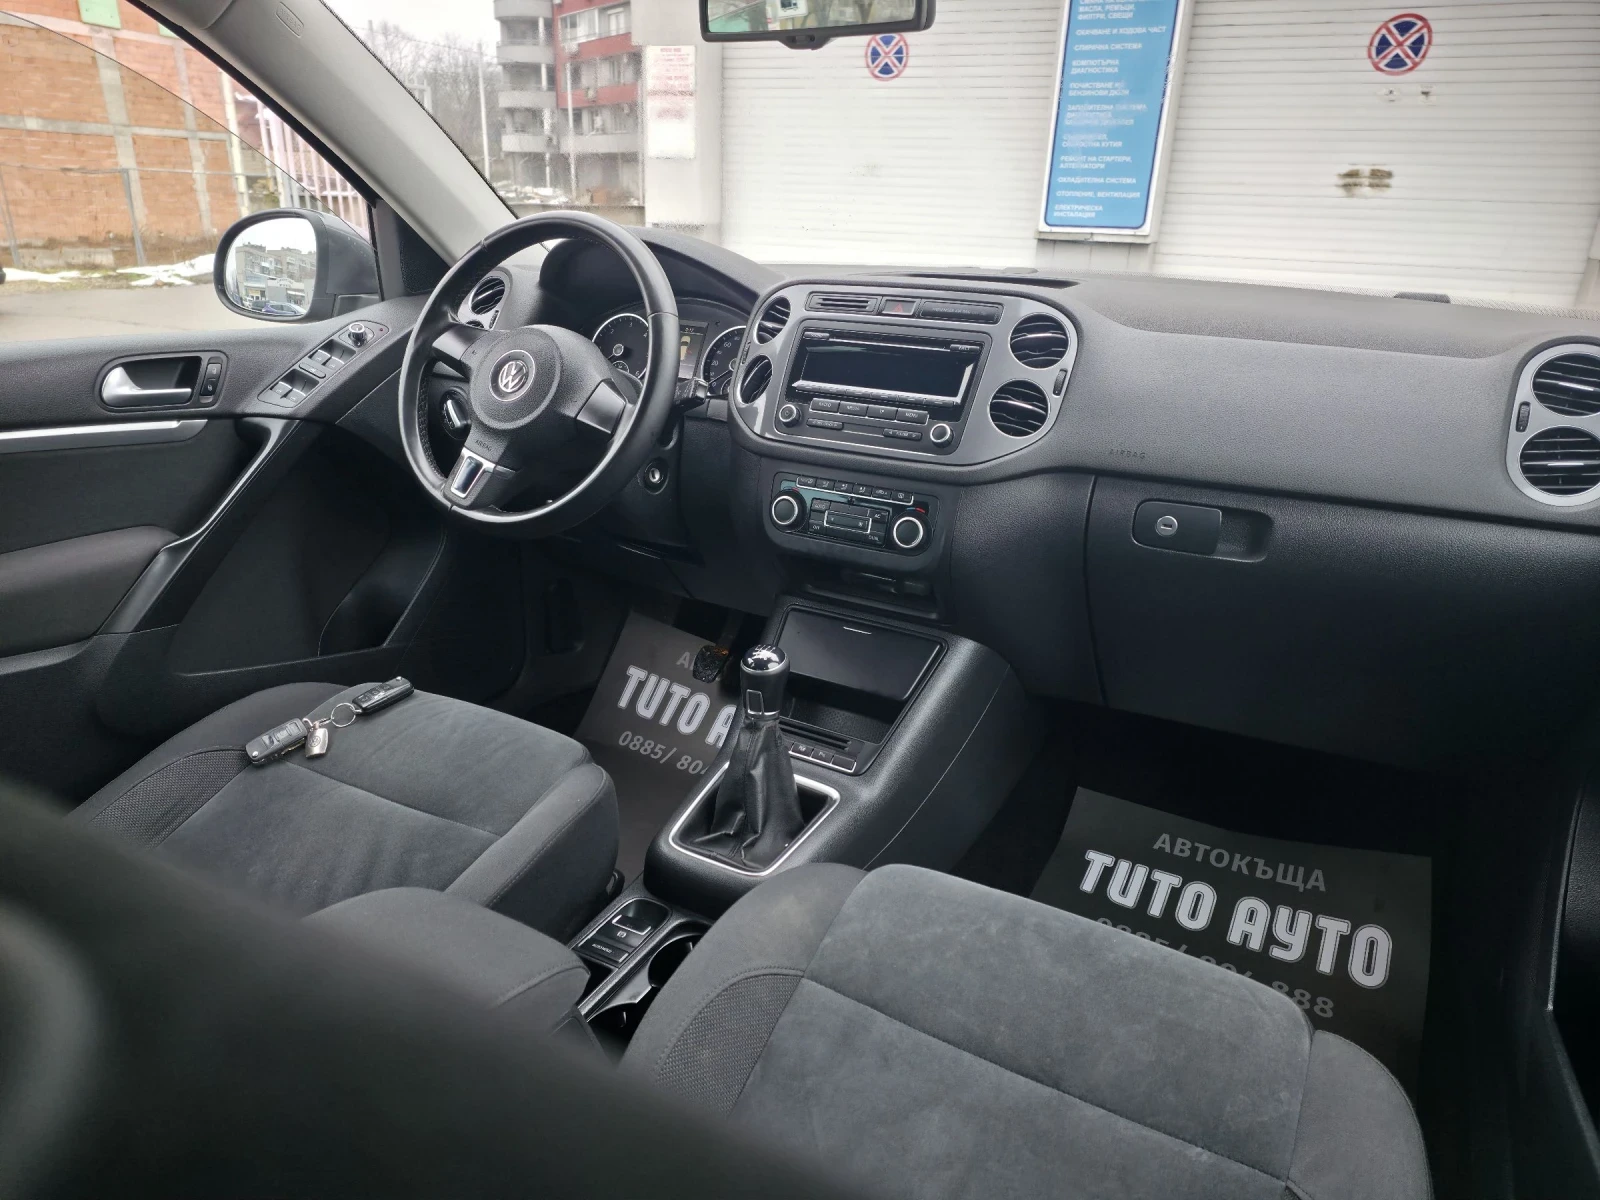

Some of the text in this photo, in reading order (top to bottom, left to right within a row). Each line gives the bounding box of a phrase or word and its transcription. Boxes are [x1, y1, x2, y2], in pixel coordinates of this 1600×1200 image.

[617, 664, 711, 736] TUTO
[618, 730, 677, 764] 0885/
[1079, 849, 1217, 931] TUTO
[1152, 832, 1327, 892] АВТОКЪЩА
